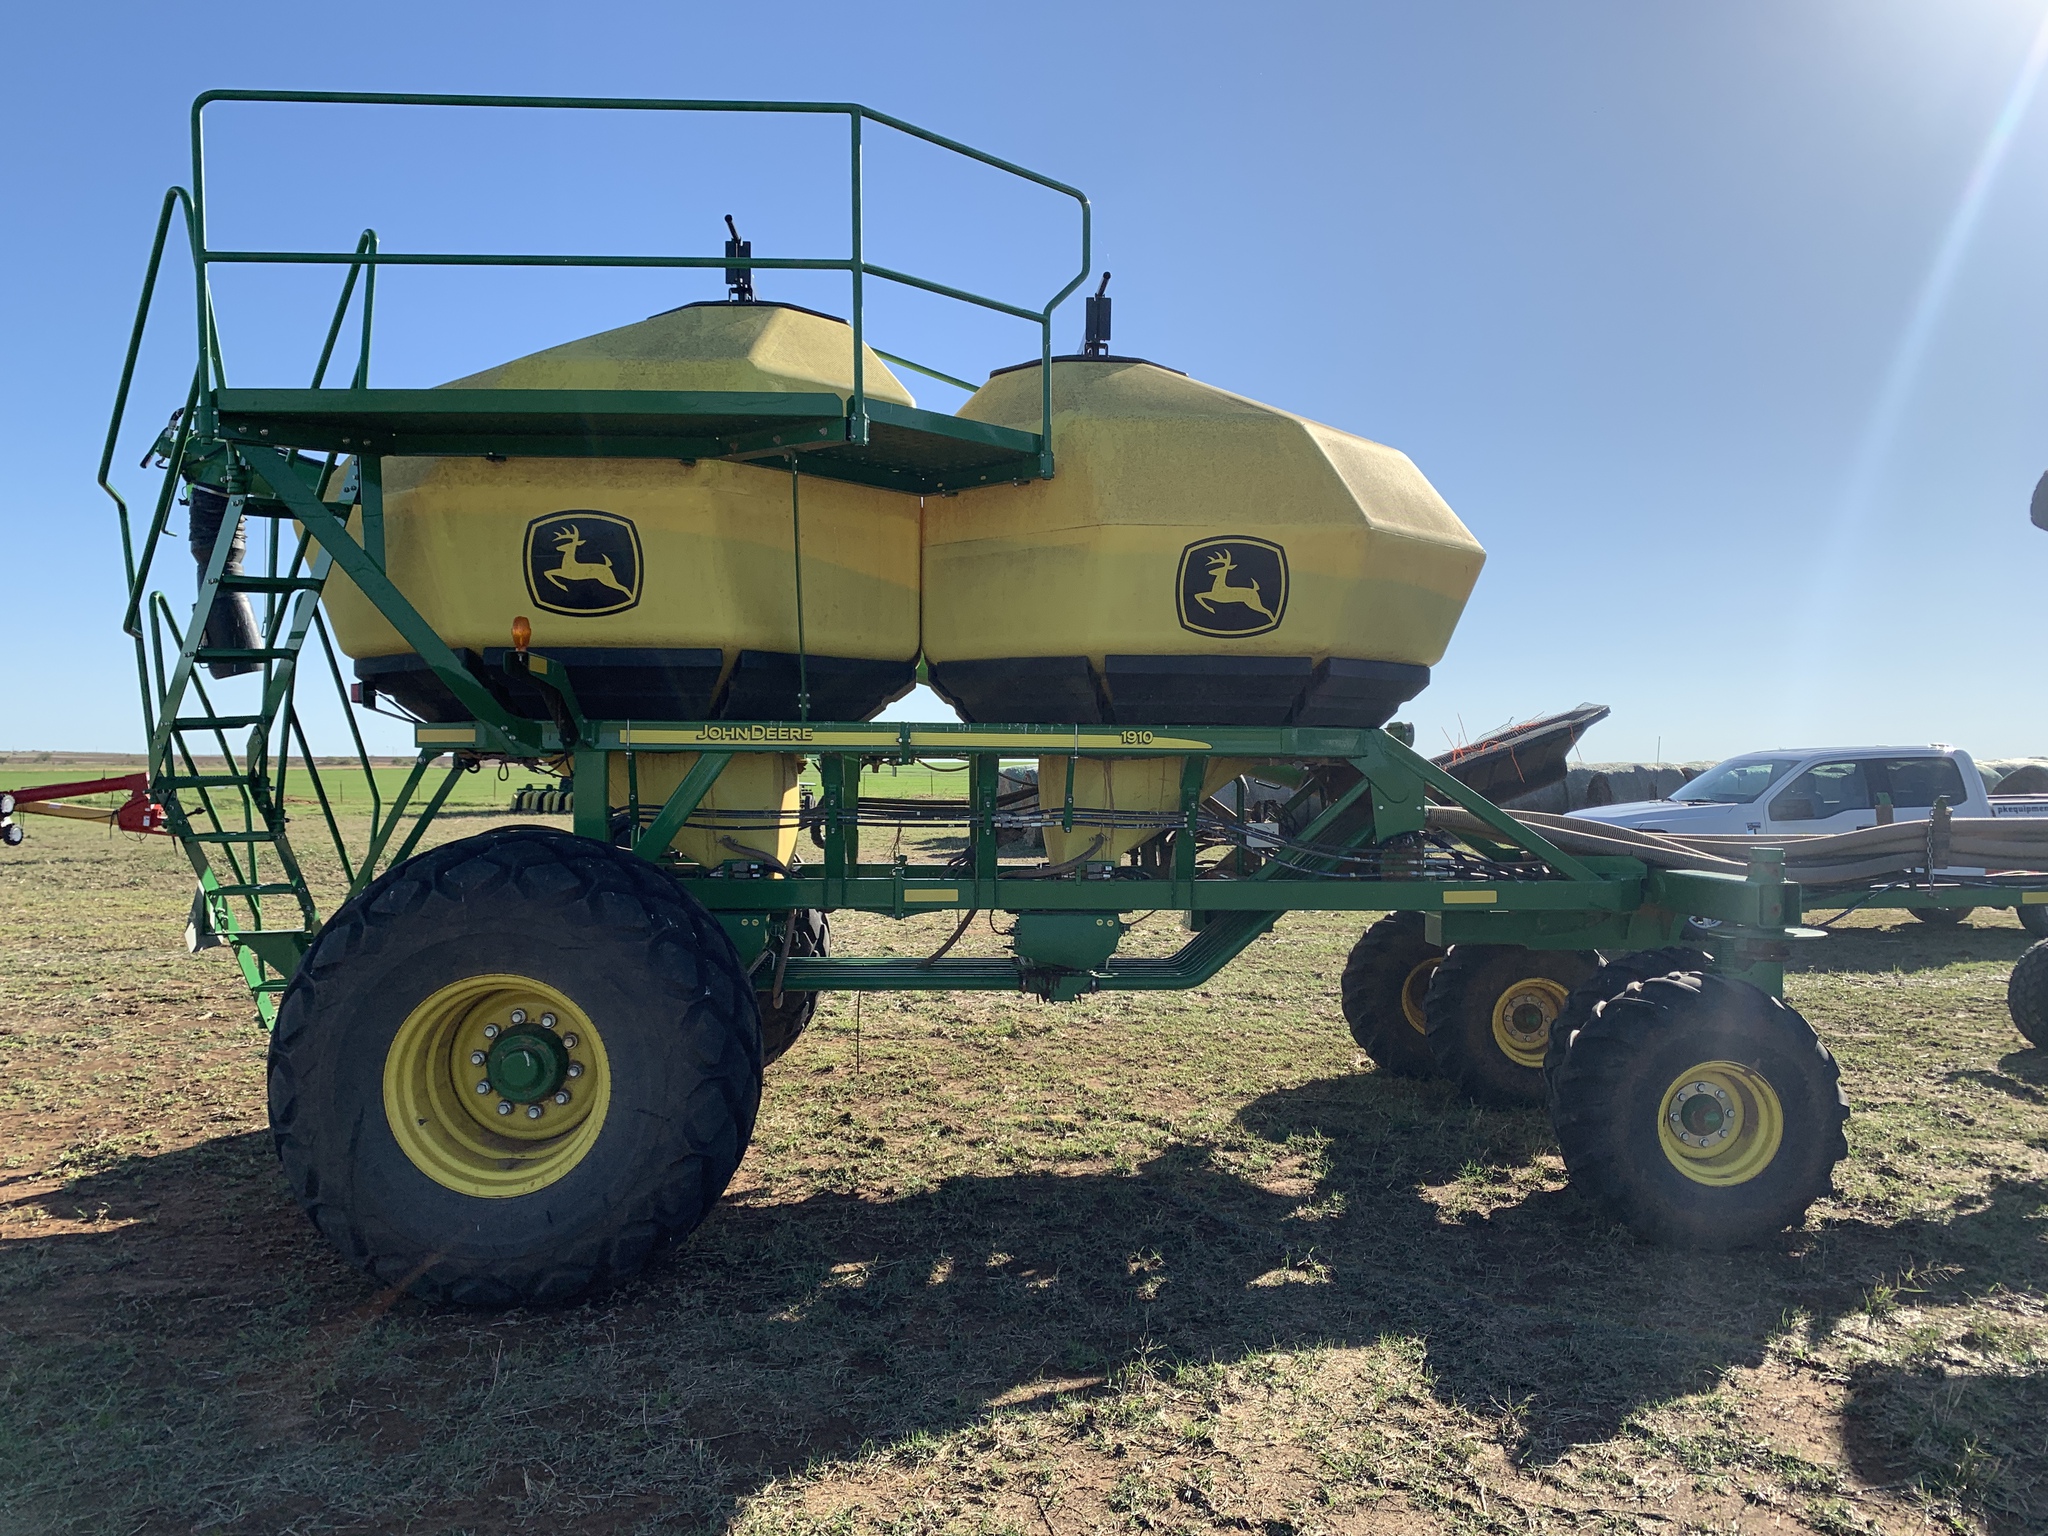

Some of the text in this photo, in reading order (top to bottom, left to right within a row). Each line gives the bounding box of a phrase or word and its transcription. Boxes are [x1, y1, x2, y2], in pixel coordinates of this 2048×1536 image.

[697, 725, 813, 741] JOHN DEERE
[1121, 730, 1153, 744] 1910
